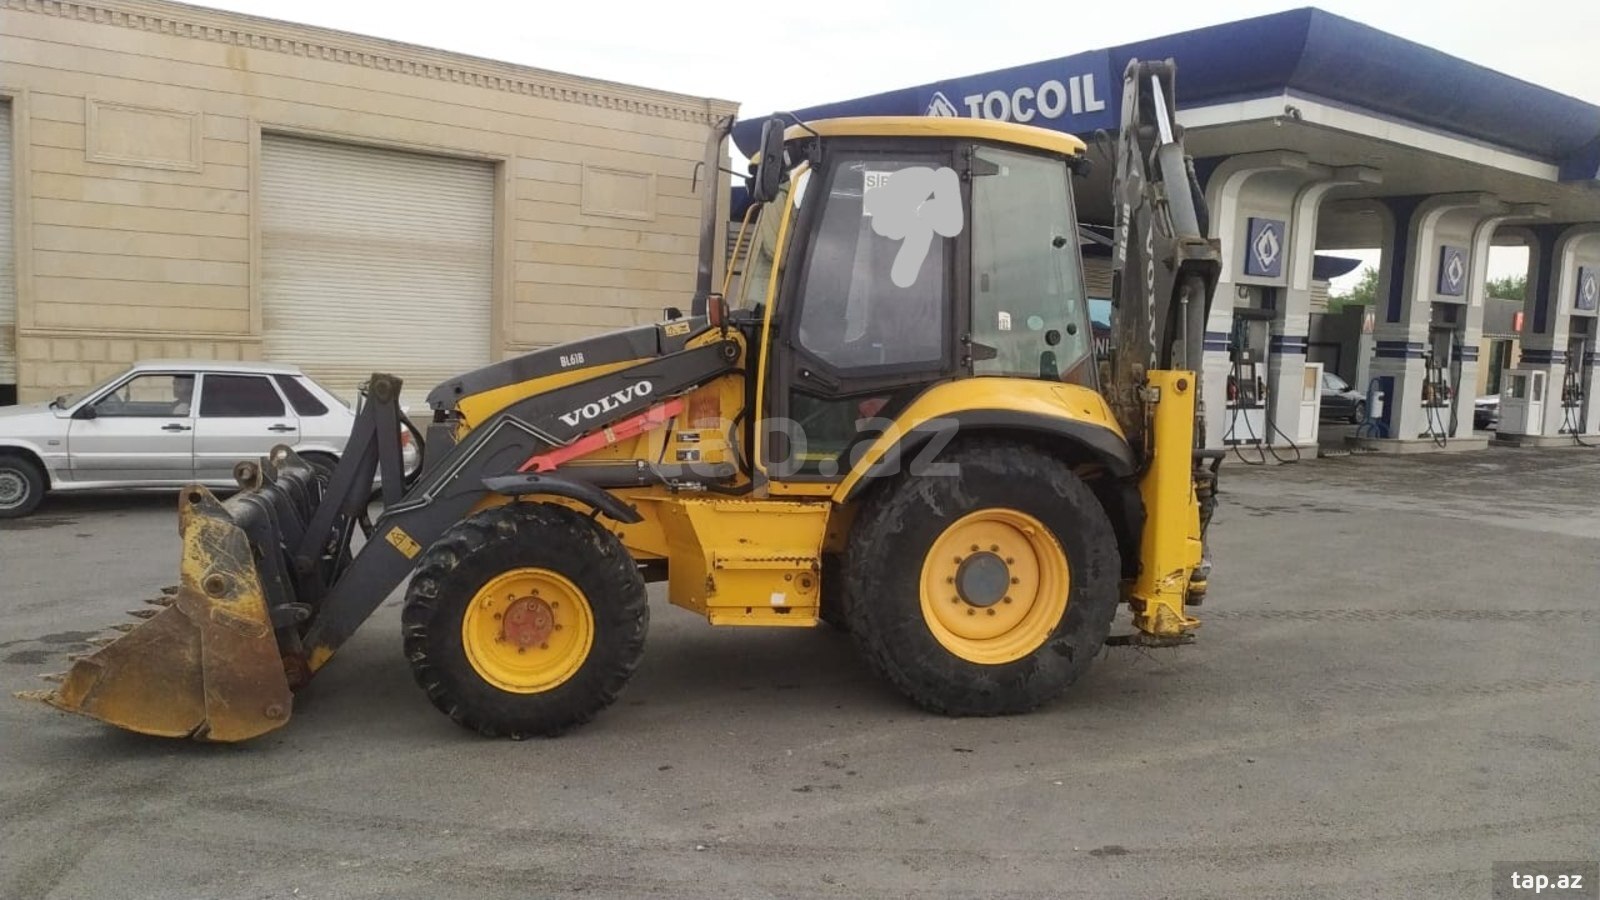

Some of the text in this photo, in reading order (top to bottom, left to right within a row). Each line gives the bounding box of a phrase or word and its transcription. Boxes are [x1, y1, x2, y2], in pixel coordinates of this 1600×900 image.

[964, 73, 1105, 123] TOCOIL
[560, 353, 585, 368] BL61B
[558, 380, 653, 427] VOLVO
